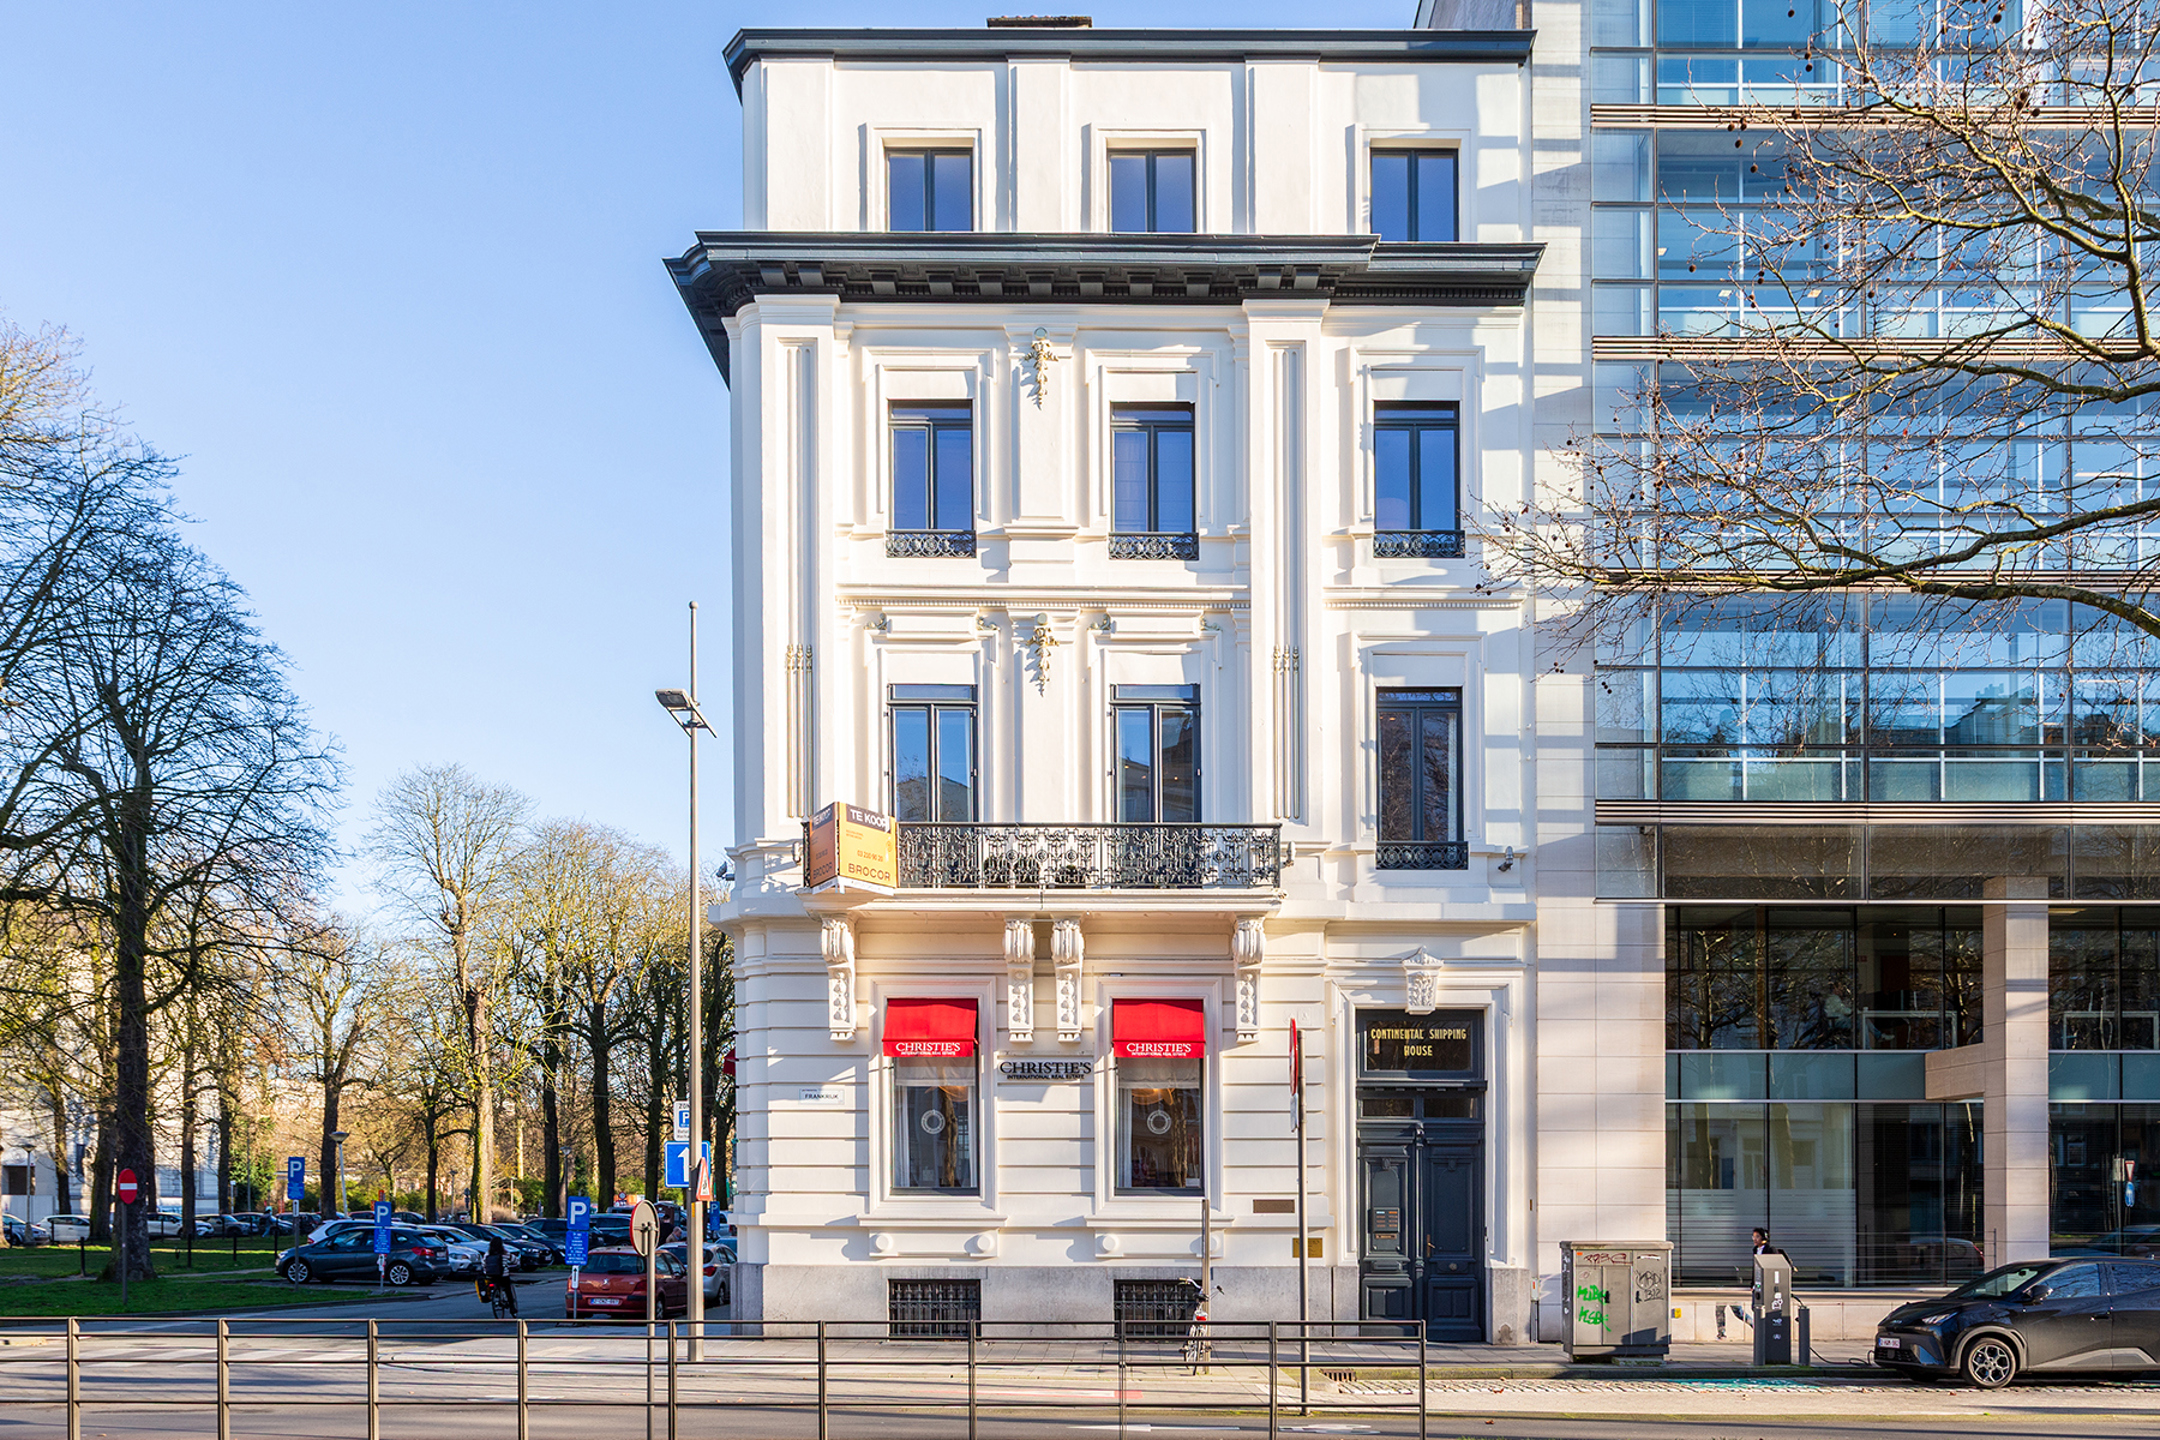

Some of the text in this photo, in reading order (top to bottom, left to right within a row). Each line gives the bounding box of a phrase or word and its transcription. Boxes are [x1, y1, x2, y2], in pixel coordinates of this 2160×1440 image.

[850, 809, 864, 821] TE
[847, 862, 891, 882] BROCOR
[1370, 1028, 1467, 1040] CONTINENTAL SHIPPING
[895, 1042, 961, 1052] CHRISTIE'S
[1126, 1042, 1192, 1053] CHRISTIE'S
[1403, 1045, 1433, 1057] HOUSE
[999, 1061, 1092, 1075] CHRISTIE'S
[682, 1112, 690, 1124] P
[290, 1160, 302, 1178] P
[376, 1205, 389, 1223] P
[570, 1201, 587, 1225] P
